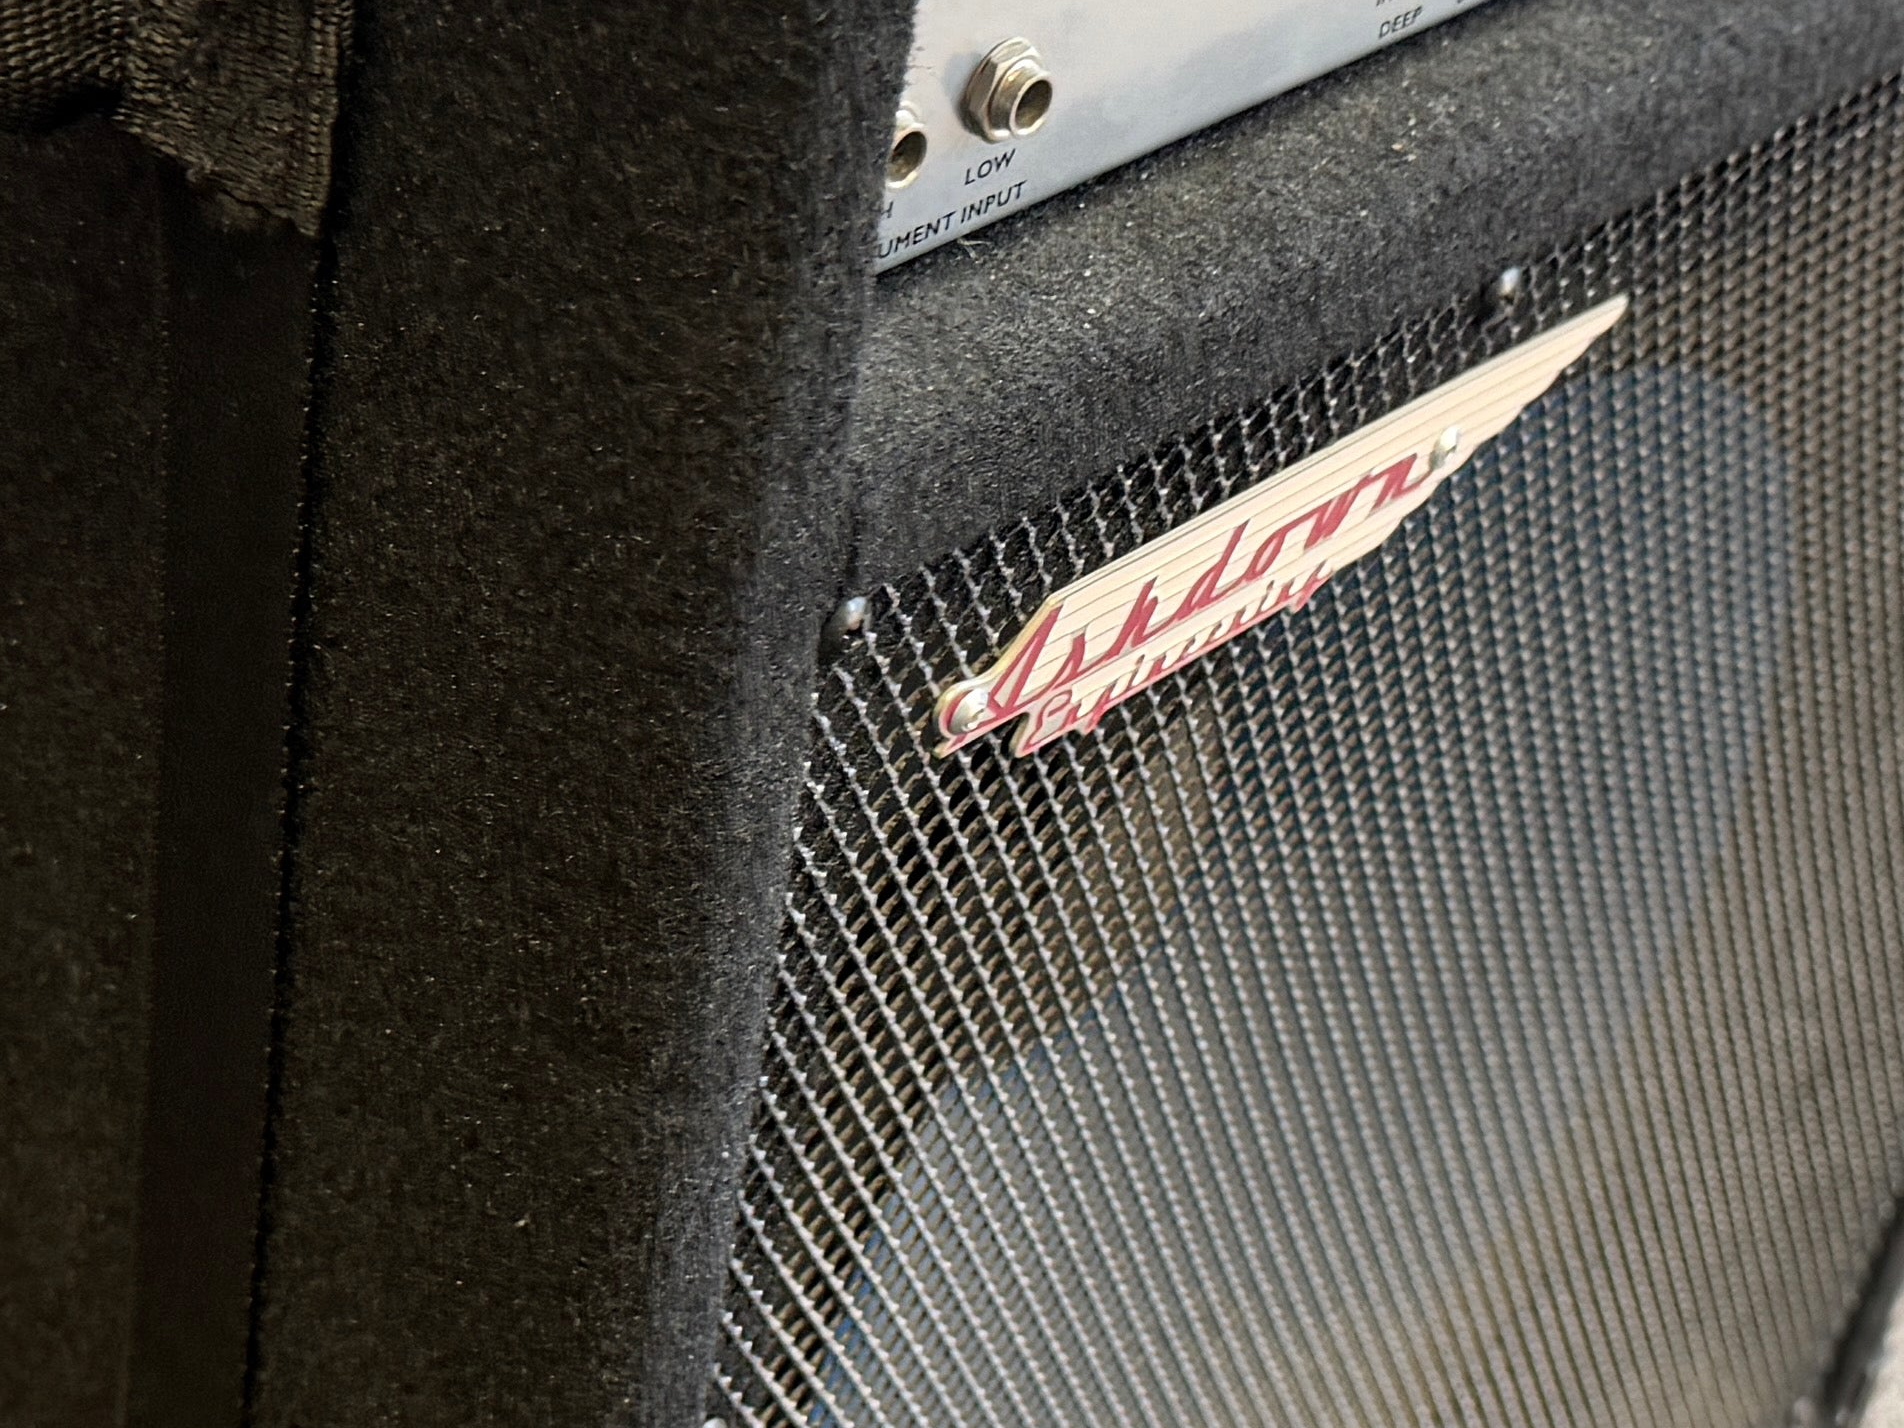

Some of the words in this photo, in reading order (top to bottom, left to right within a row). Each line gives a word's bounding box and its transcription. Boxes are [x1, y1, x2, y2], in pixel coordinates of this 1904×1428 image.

[1378, 5, 1423, 39] DEEP
[964, 147, 1016, 186] LOW
[876, 210, 957, 259] UMENT
[960, 179, 1028, 224] INPUT
[939, 452, 1434, 752] Ashdown
